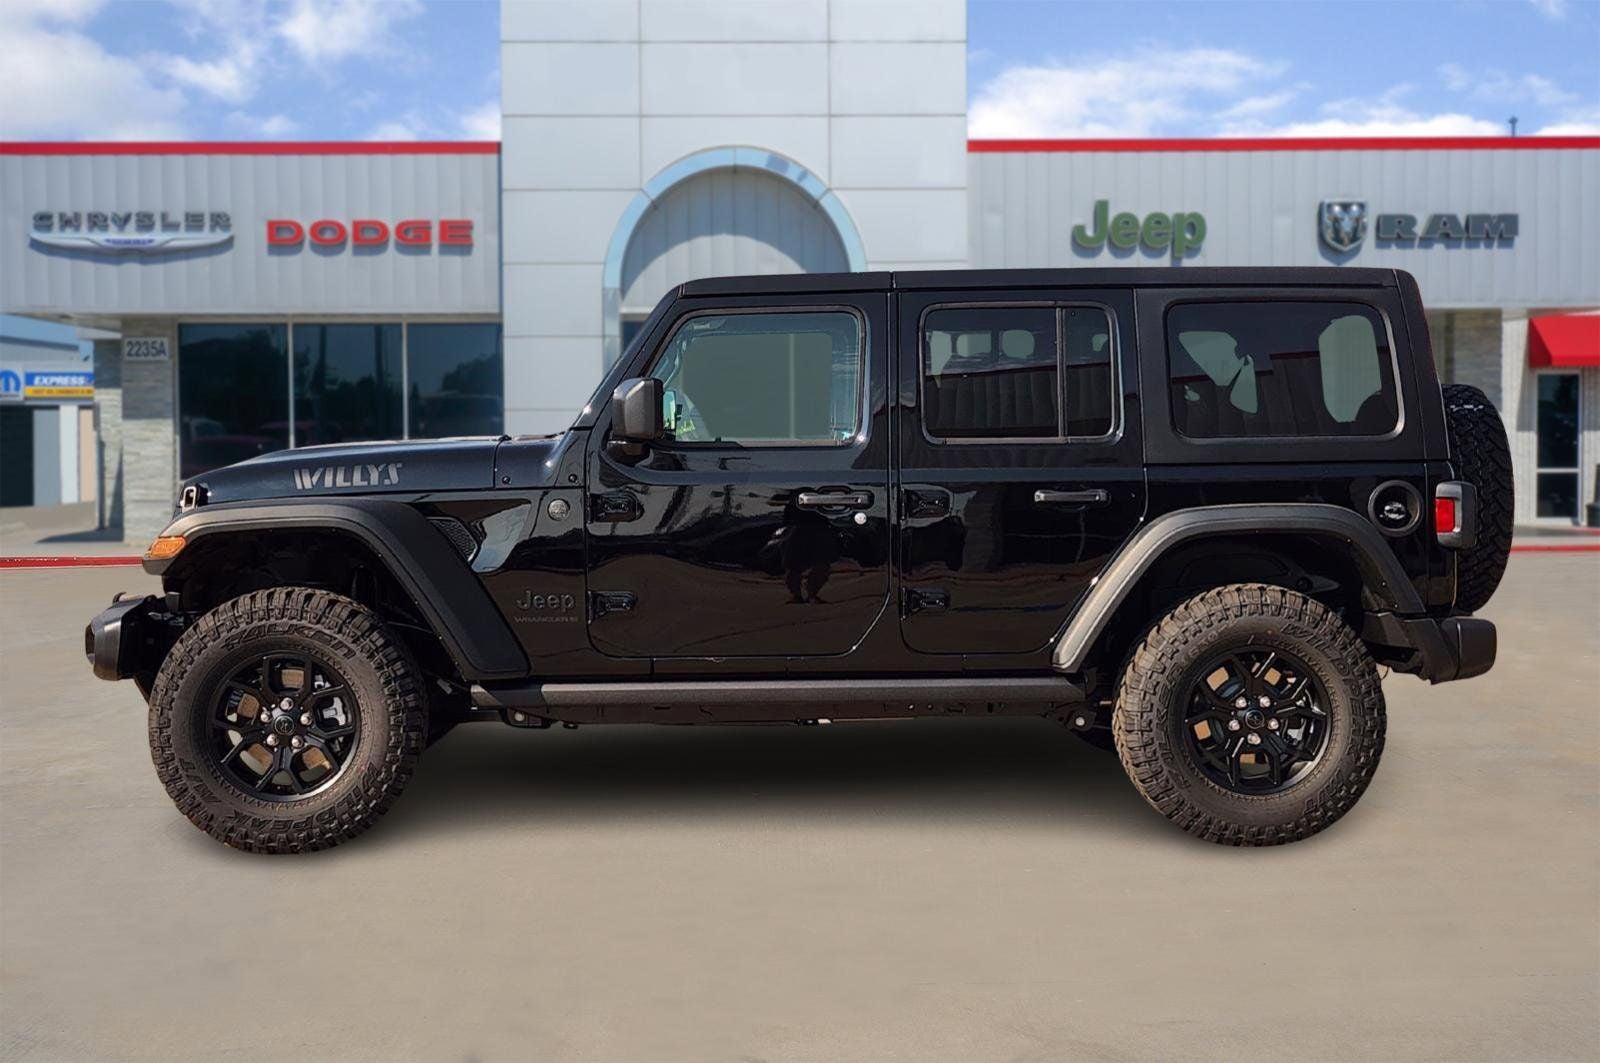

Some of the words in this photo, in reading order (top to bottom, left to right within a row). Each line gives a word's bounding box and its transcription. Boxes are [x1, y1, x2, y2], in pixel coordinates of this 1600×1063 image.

[33, 212, 232, 231] CHRYSLER
[266, 219, 474, 246] DODGE
[1072, 200, 1207, 256] Jeep
[1376, 213, 1519, 239] RAM
[126, 340, 167, 358] 2235A
[33, 375, 86, 386] EXPRESS
[293, 463, 403, 490] WILLYS
[516, 590, 575, 613] Jeep
